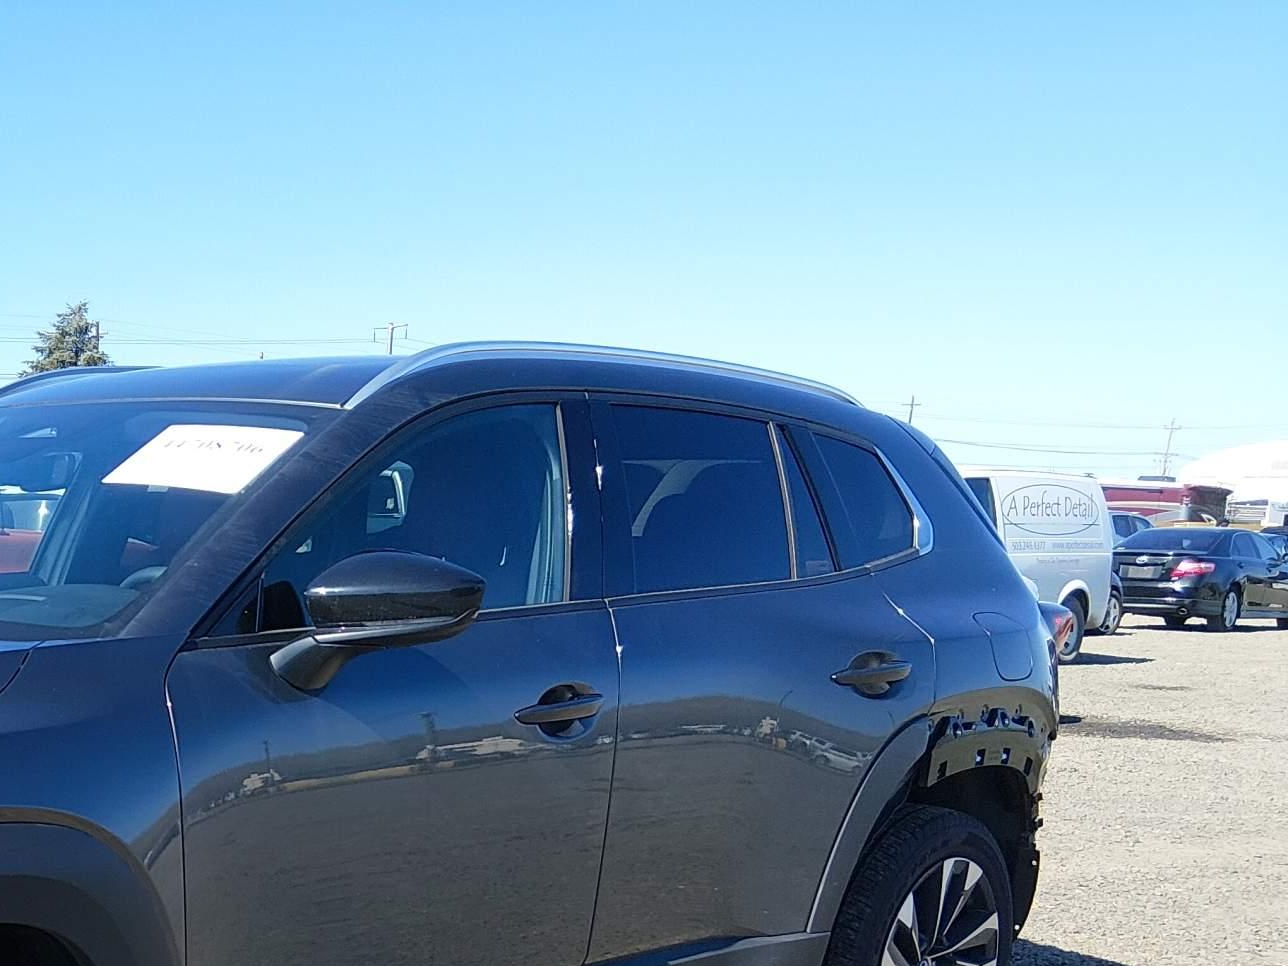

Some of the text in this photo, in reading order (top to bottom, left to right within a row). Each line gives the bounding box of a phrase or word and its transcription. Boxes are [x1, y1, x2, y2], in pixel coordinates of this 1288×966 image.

[1007, 490, 1093, 520] A Perfect Detail
